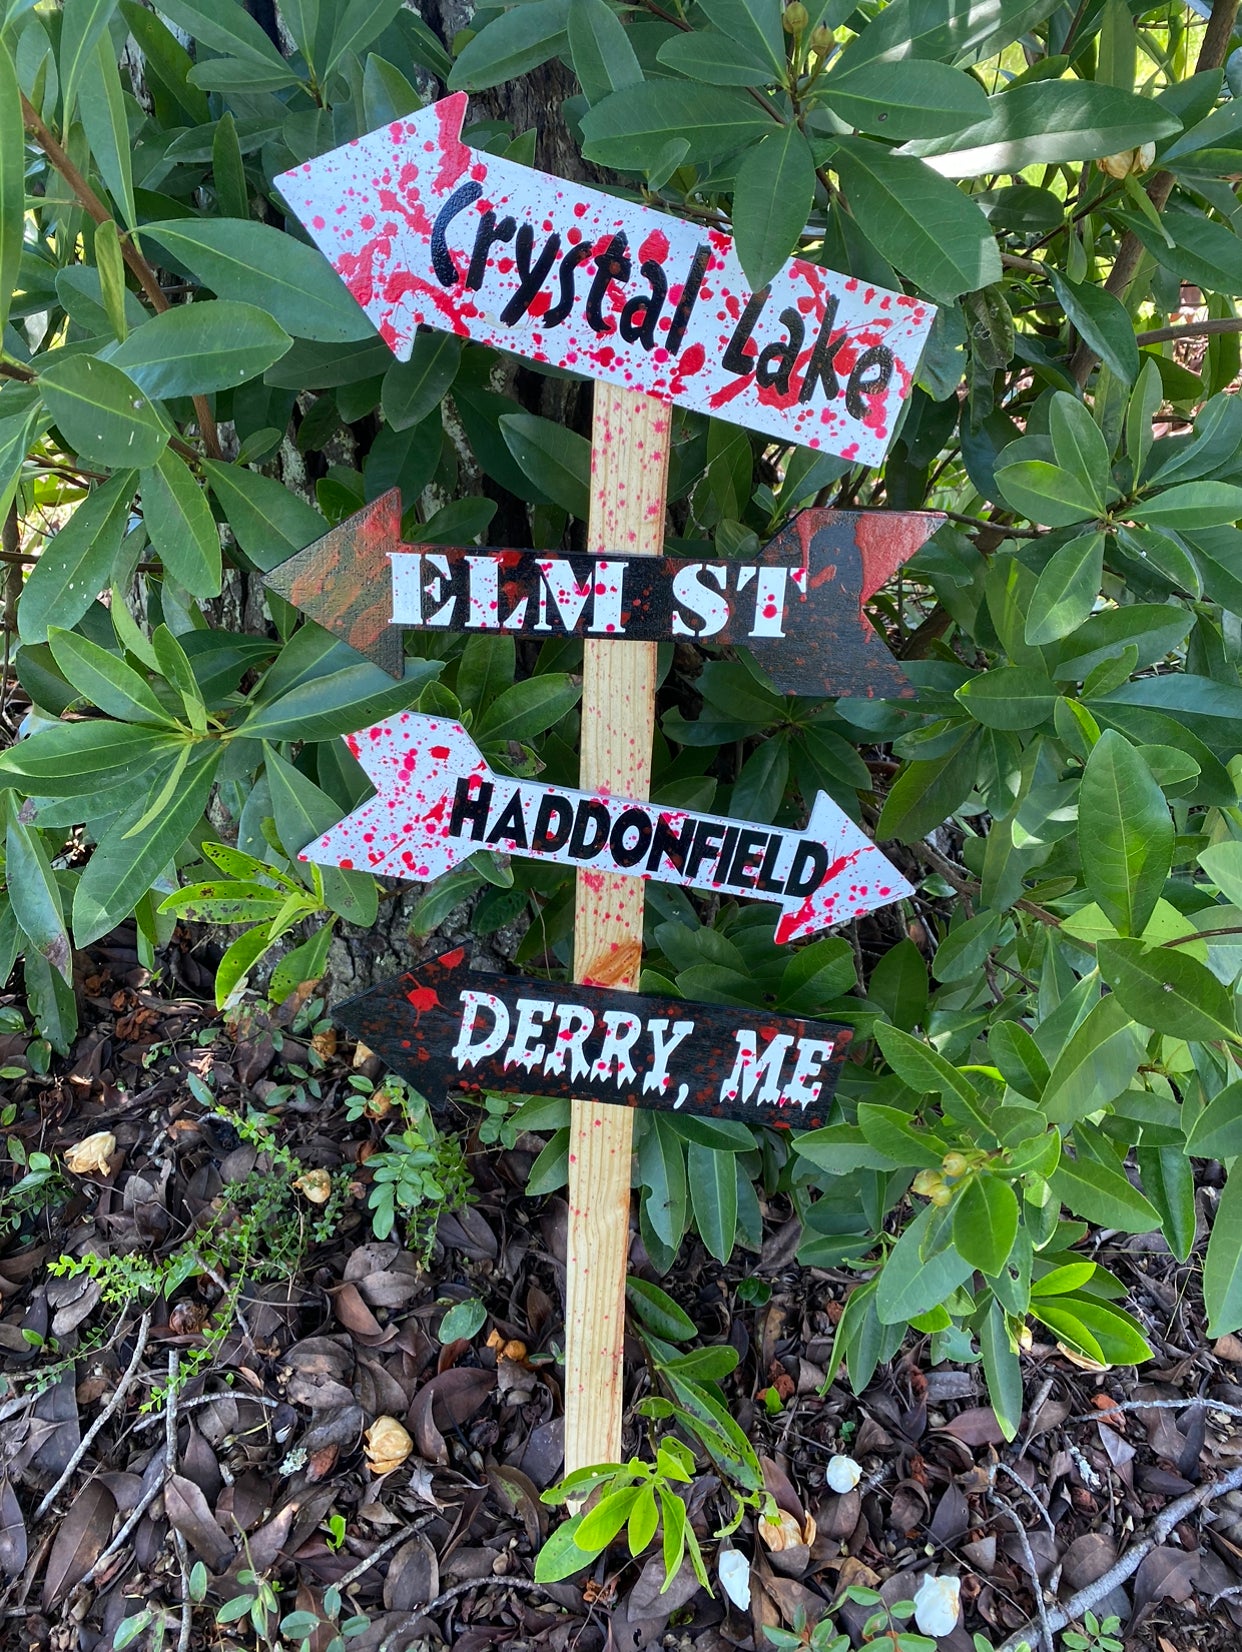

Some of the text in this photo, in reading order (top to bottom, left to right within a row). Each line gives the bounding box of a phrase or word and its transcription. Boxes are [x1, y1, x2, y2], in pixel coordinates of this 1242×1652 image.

[431, 181, 894, 420] Crystal Lake
[386, 552, 807, 637] ELM ST
[449, 778, 829, 898] HADDONFIELD
[451, 990, 835, 1111] DERRY, ME
